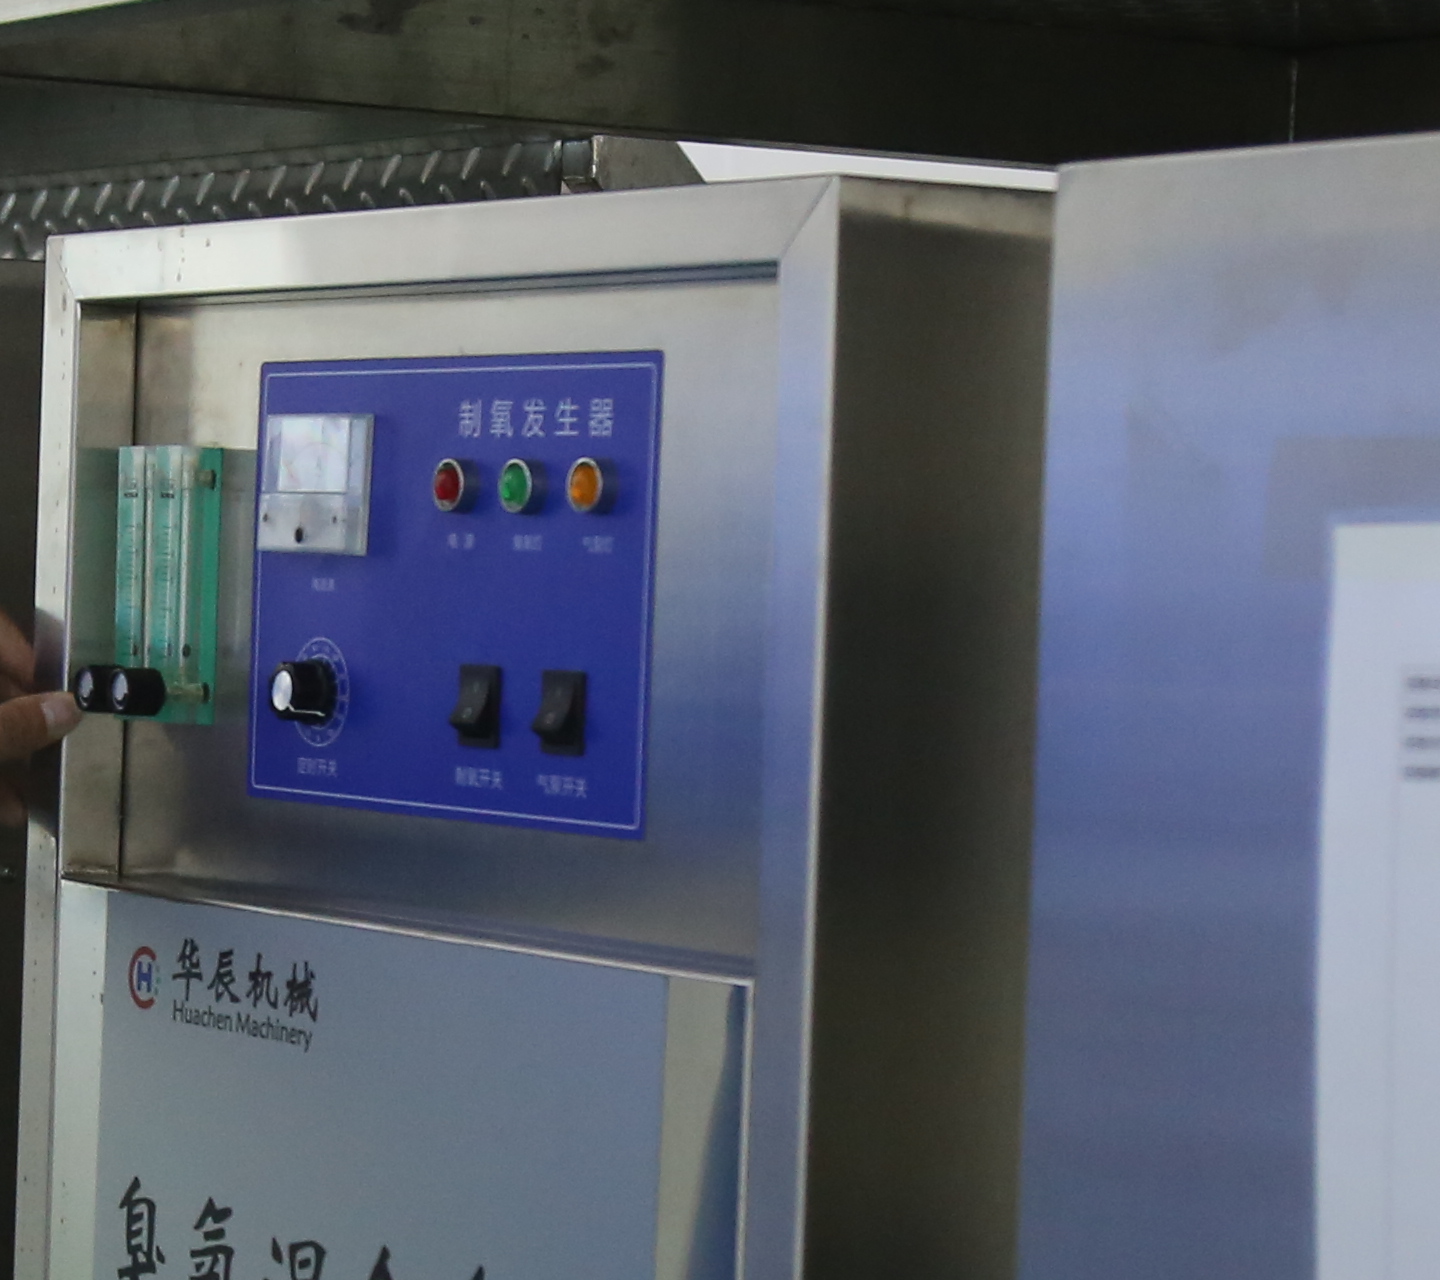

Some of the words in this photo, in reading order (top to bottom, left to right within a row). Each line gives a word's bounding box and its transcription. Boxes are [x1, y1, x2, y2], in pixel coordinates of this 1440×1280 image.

[458, 398, 615, 439] 制氧发生器
[172, 938, 319, 1023] 华辰机械
[173, 1000, 233, 1032] Huachen
[235, 1011, 313, 1054] Machinery
